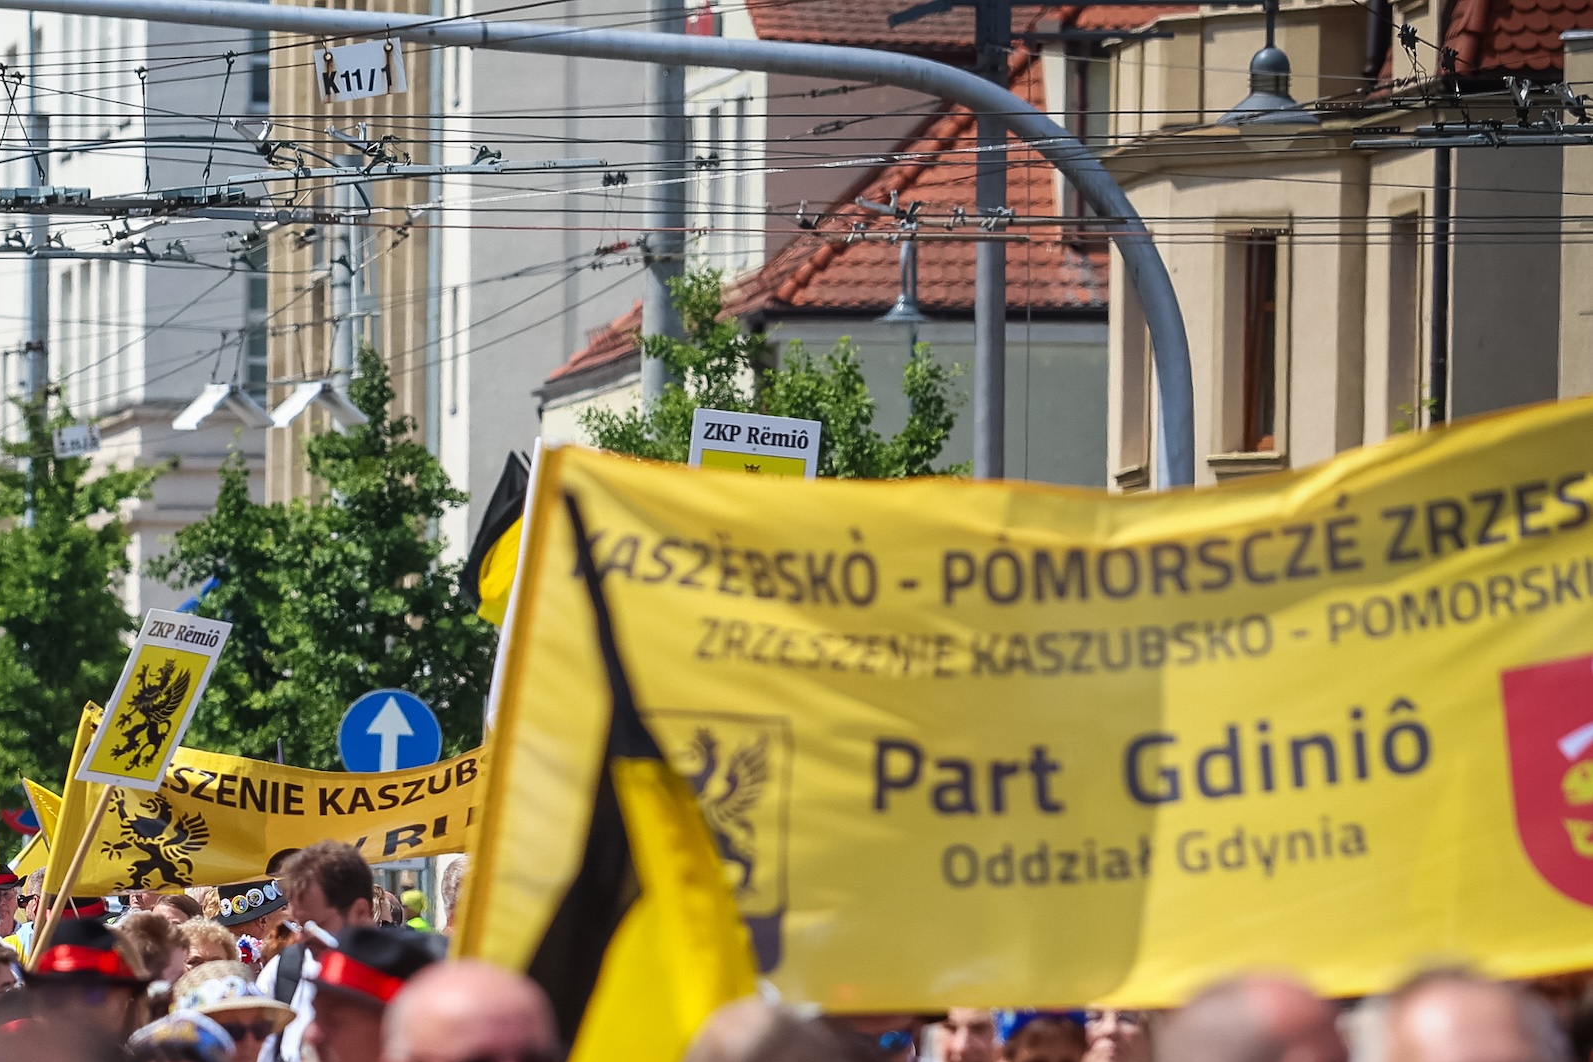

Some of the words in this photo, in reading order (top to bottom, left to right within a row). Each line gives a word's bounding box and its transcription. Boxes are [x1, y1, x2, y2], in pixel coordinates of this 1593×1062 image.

[703, 422, 742, 442] ZKP
[746, 426, 809, 449] Rëmiô
[1382, 470, 1591, 563] ZRZES
[148, 621, 175, 638] ZKP
[970, 613, 1275, 678] KASZUBSKO
[163, 763, 305, 816] SZENIE
[319, 757, 481, 816] KASZUB
[872, 736, 1066, 815] Part
[1123, 697, 1432, 808] Gdiniô
[941, 837, 1152, 888] Oddział
[1175, 815, 1368, 876] Gdynia
